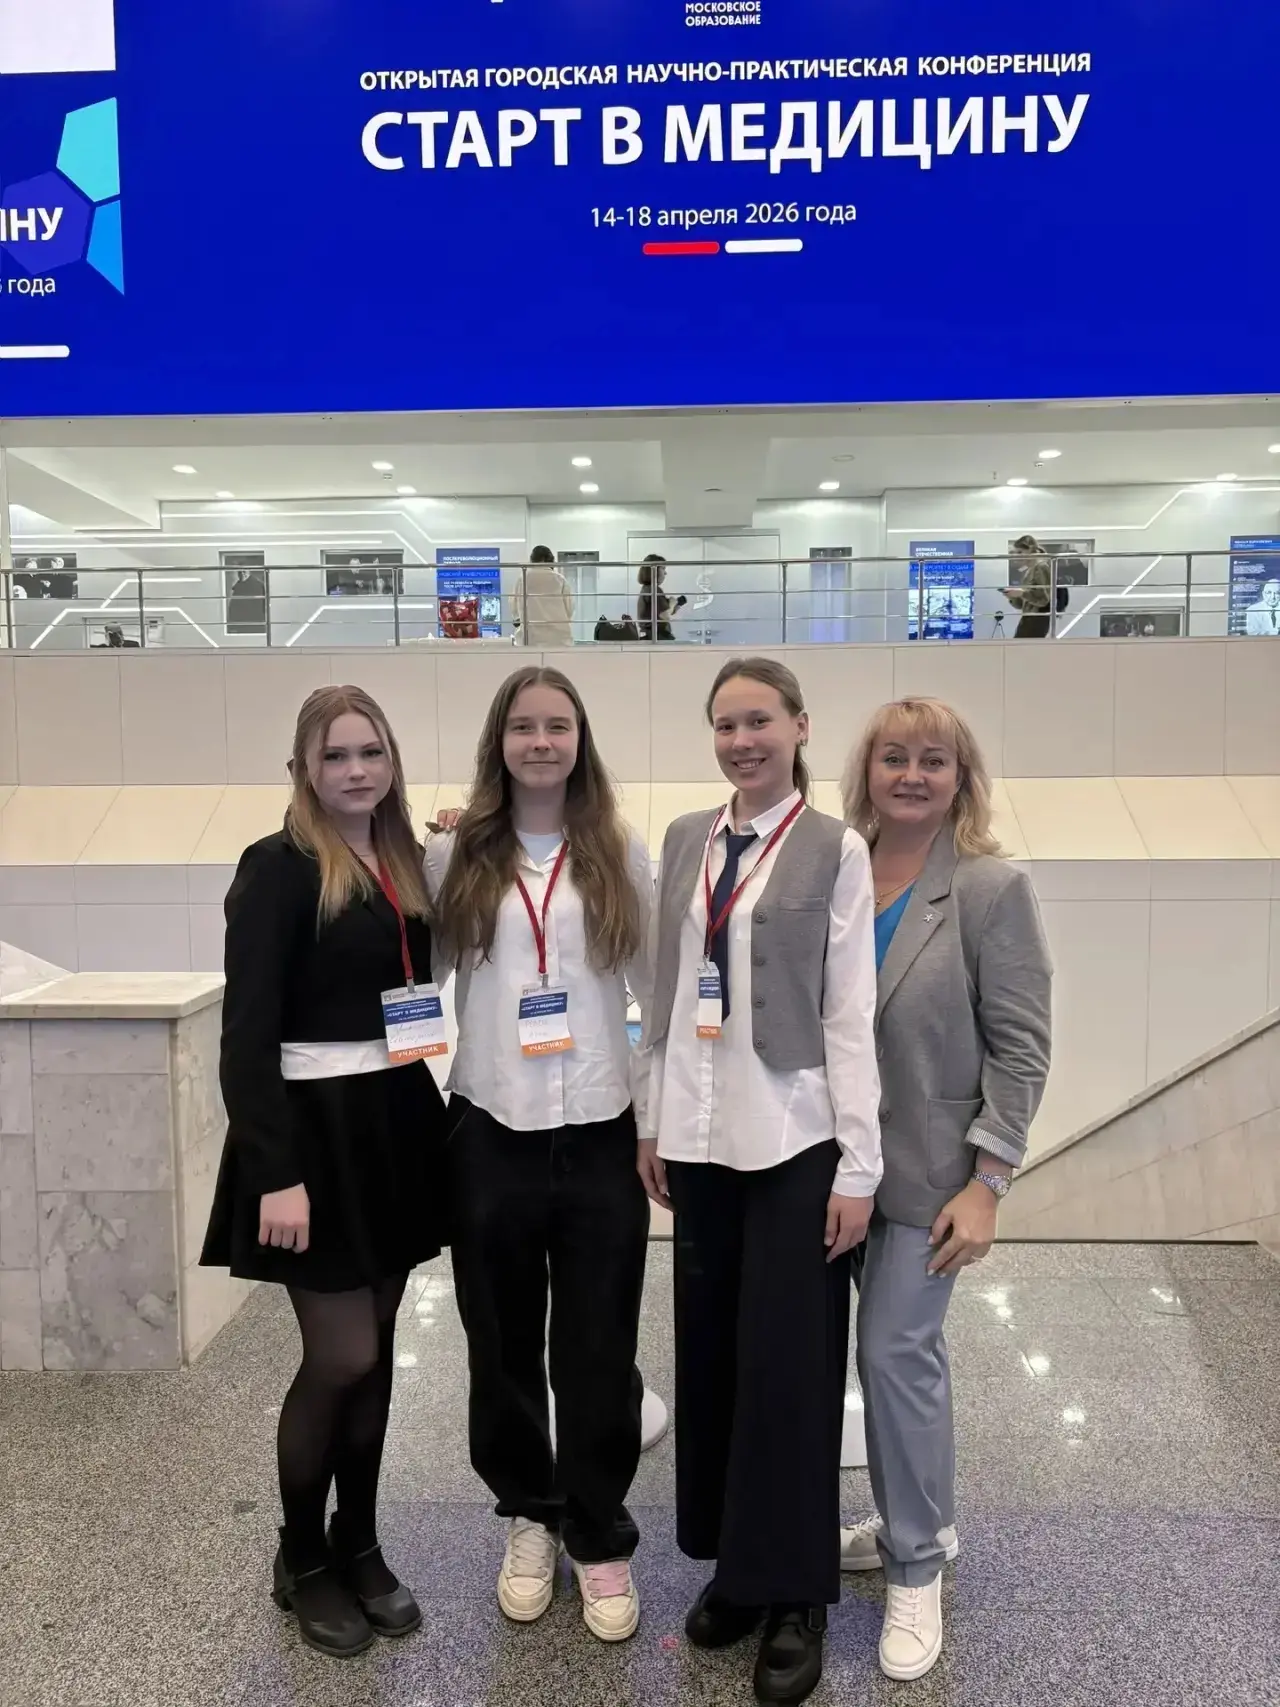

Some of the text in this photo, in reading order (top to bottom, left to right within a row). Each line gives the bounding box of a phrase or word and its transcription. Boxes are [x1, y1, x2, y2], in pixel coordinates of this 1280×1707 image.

[685, 0, 761, 13] МОСКОВСКОЕ
[685, 14, 761, 27] ОБРАЗОВАНИЕ
[359, 52, 1091, 91] ОТКРЫТАЯ ГОРОДСКАЯ НАУЧНО-ПРАКТИЧЕСКАЯ КОНФЕРЕНЦИЯ
[361, 93, 1090, 174] СТАРТ В МЕДИЦИНУ
[0, 207, 64, 242] НУ
[591, 202, 857, 231] 14-18 апреля 2026 года
[8, 277, 56, 297] года
[397, 1046, 439, 1058] УЧАСТНИК
[528, 1041, 565, 1052] УЧАСТНИК
